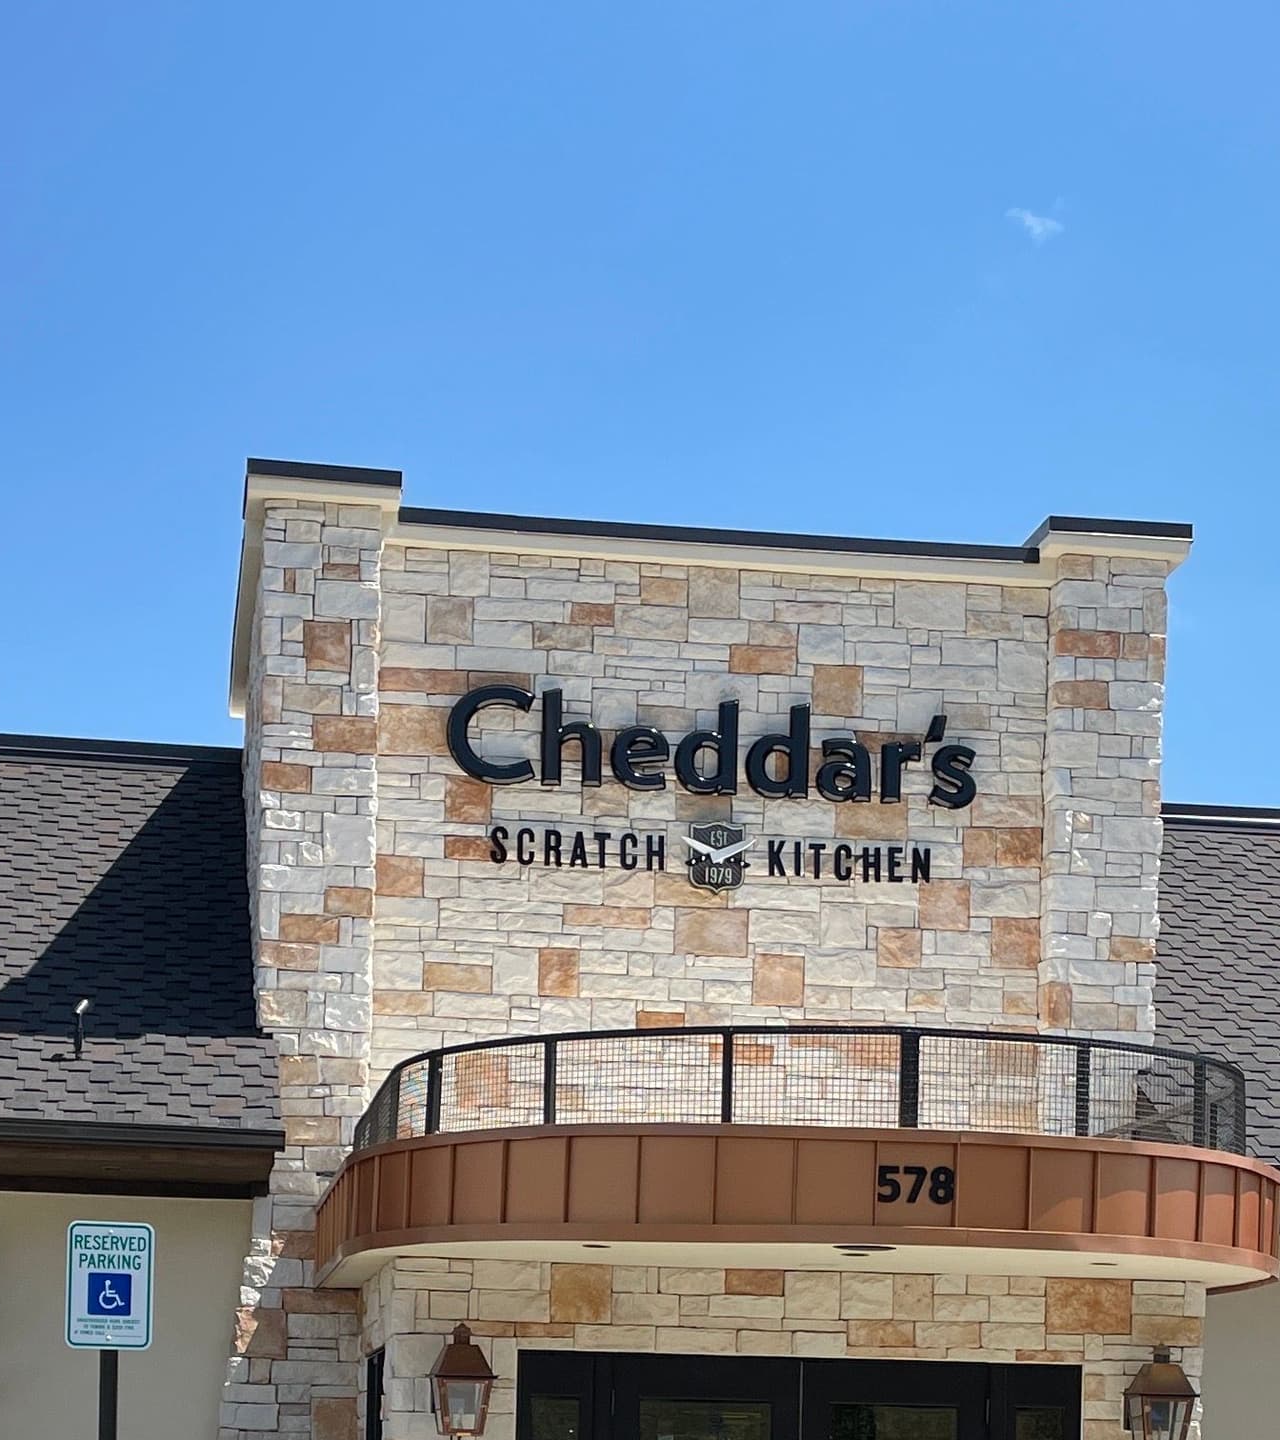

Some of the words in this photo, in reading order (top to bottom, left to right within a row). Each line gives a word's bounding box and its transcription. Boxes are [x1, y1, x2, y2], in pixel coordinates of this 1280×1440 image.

[447, 684, 977, 809] Cheddar's
[710, 831, 728, 847] EST
[490, 826, 665, 871] SCRATCH
[767, 840, 931, 883] KITCHEN
[705, 866, 732, 884] 1979
[878, 1165, 955, 1205] 578
[74, 1234, 146, 1252] RESERVED
[79, 1253, 141, 1270] PARKING
